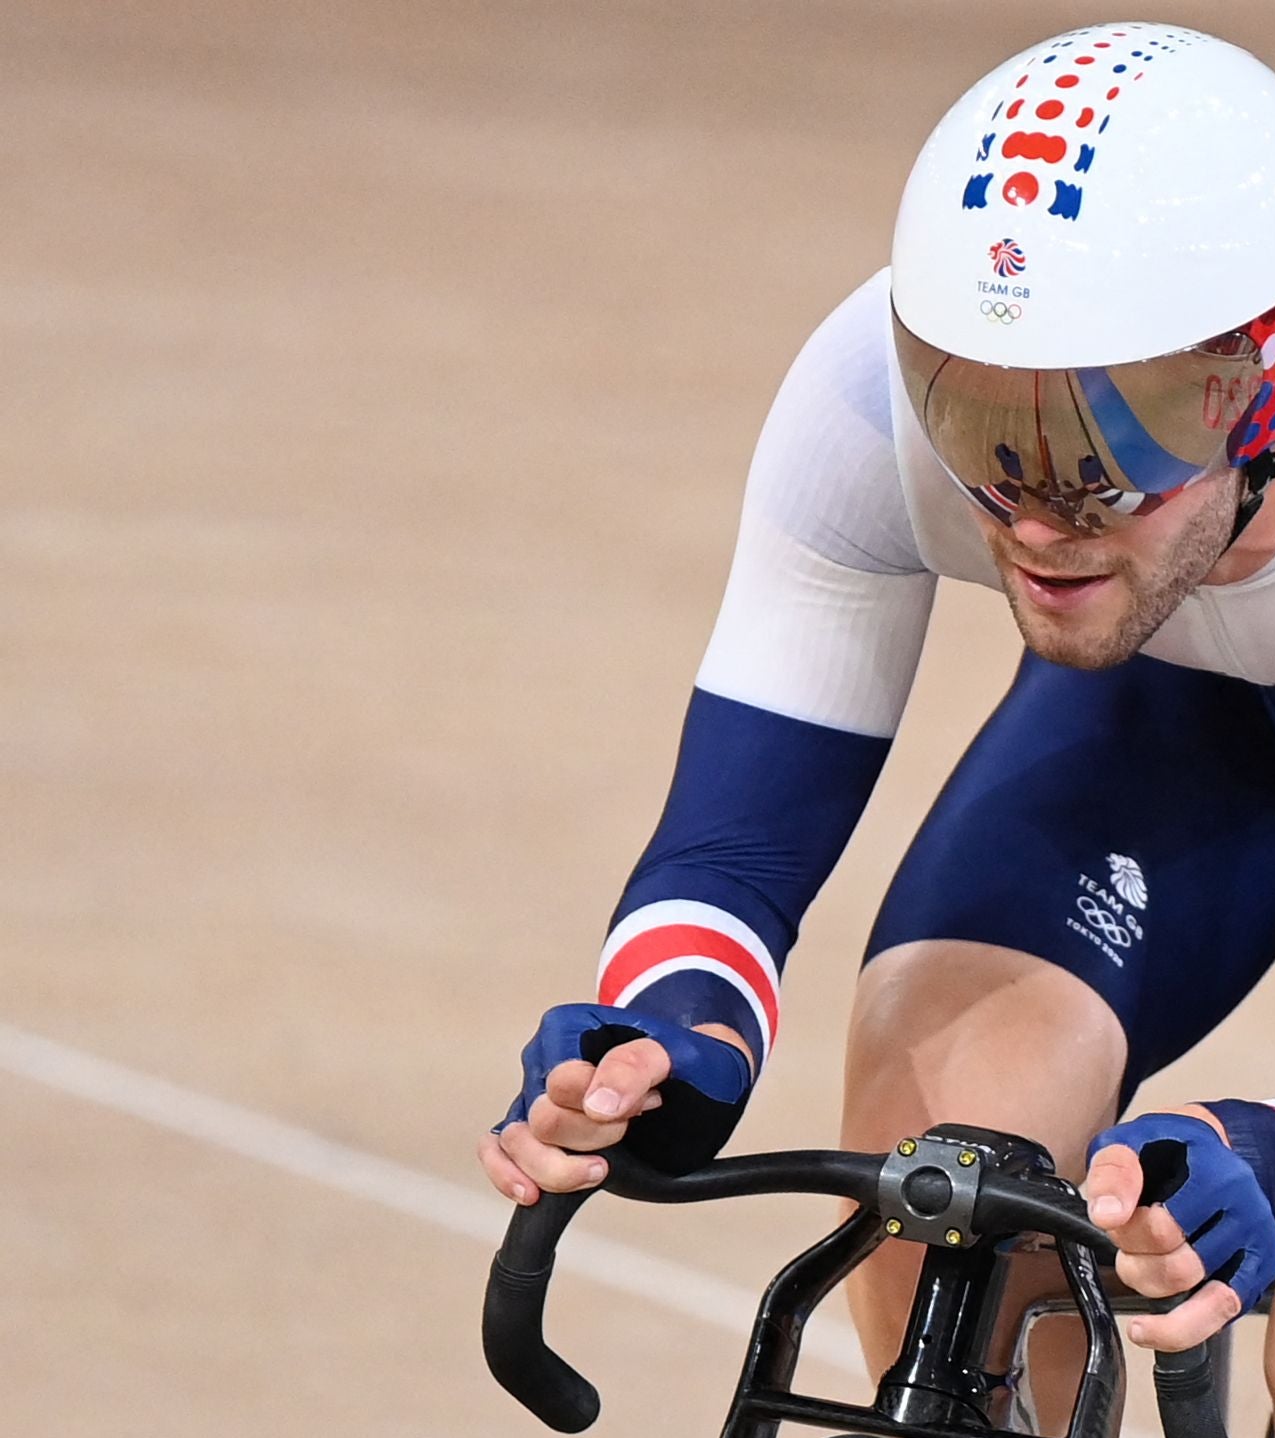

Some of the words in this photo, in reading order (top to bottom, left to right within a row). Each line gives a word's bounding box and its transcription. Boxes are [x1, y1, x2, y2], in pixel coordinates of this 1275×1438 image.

[977, 281, 1008, 296] TEAM
[1012, 286, 1030, 299] GB
[1077, 873, 1124, 916] TEAM
[1125, 914, 1144, 941] GB
[1066, 917, 1102, 946] TOKYO
[1101, 943, 1124, 968] 2020
